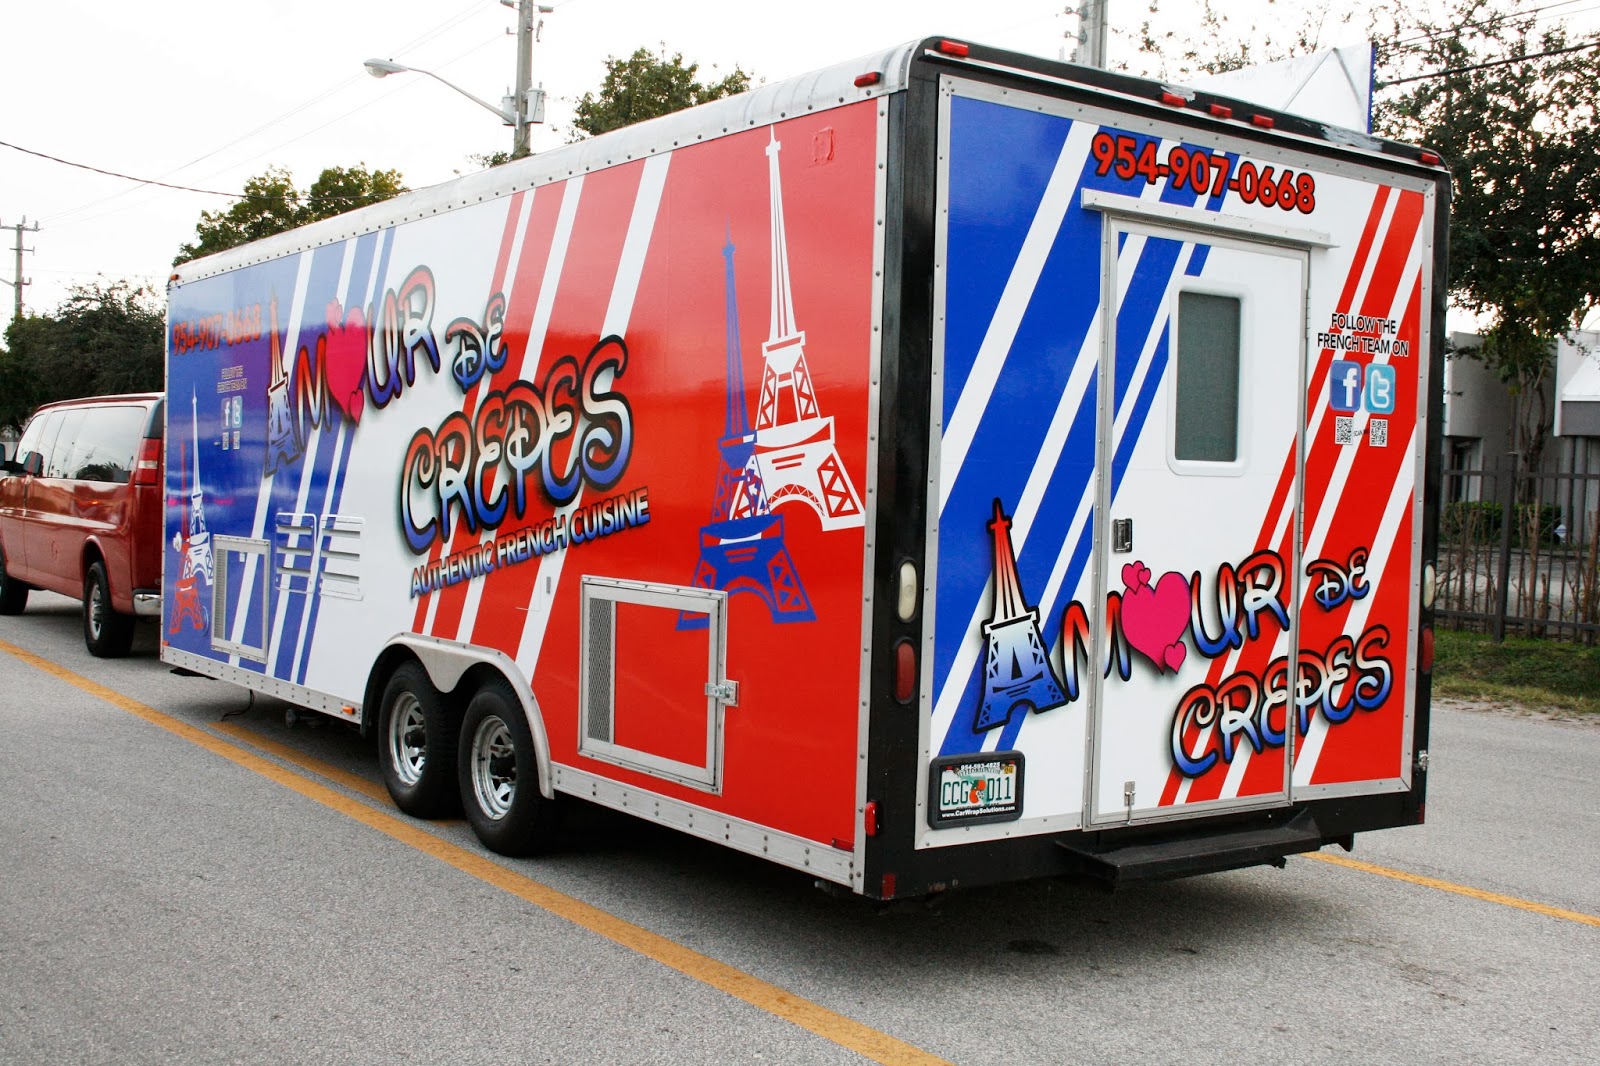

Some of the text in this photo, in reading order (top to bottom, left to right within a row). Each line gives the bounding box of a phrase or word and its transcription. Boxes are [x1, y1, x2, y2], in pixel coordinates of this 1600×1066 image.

[1091, 131, 1315, 214] 954-907-0668
[445, 292, 508, 394] DE
[1317, 332, 1409, 356] FRENCH TEAM ON
[1331, 313, 1397, 334] FOLLOW THE
[402, 334, 633, 555] CREPES
[410, 486, 650, 598] AUTHENTIC FRENCH CUISINE
[1306, 546, 1371, 612] DE
[1170, 624, 1394, 779] CREPES
[941, 806, 1015, 817] www.CarWrapSolutions.com
[942, 776, 1011, 805] CCG D11
